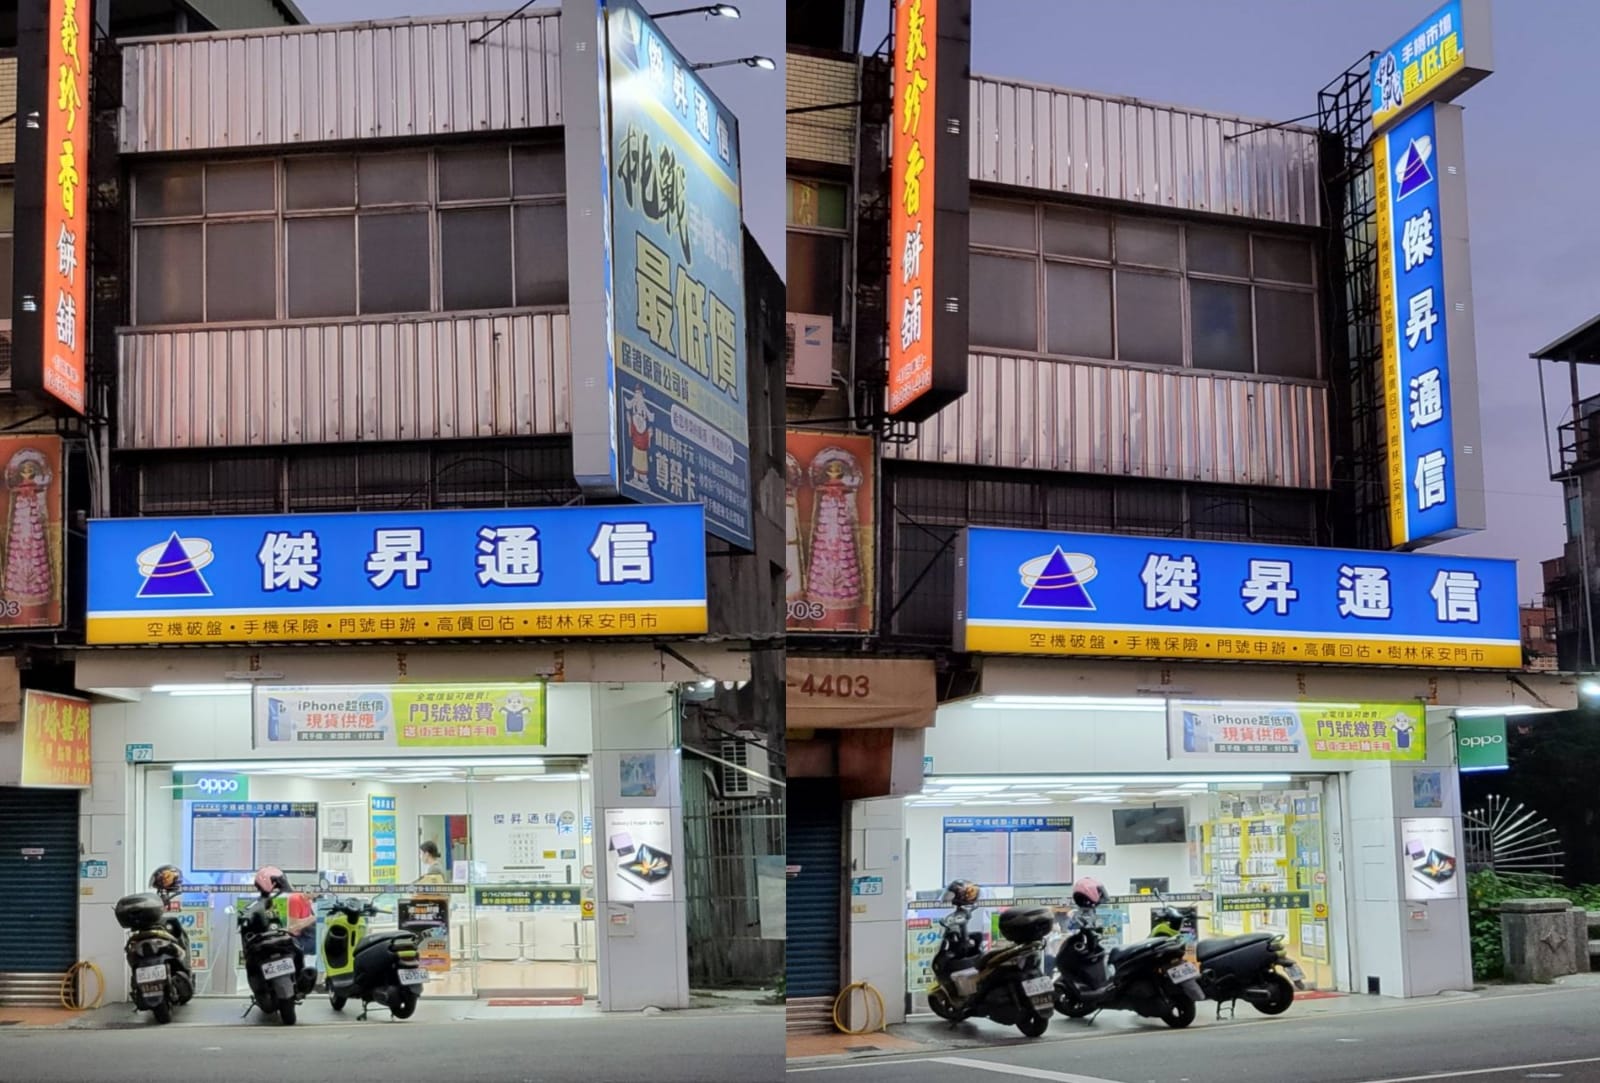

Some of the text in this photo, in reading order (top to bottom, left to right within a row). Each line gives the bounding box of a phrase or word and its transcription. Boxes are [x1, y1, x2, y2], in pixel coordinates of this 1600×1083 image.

[617, 128, 692, 266] 挑戰
[635, 230, 739, 402] 最低價
[1401, 207, 1447, 511] 傑昇通信
[655, 450, 696, 502] 尊榮卡
[257, 521, 653, 591] 傑昇通信
[1141, 553, 1481, 623] 傑昇通信
[298, 699, 384, 712] iPhone超低價
[409, 702, 494, 722] 門號繳費
[306, 713, 376, 729] 現貨供應
[1213, 712, 1294, 726] iPhone超低價
[1317, 719, 1388, 738] 門號繳費
[1222, 727, 1289, 743] 現貨供應
[493, 812, 556, 825] 傑昇通信
